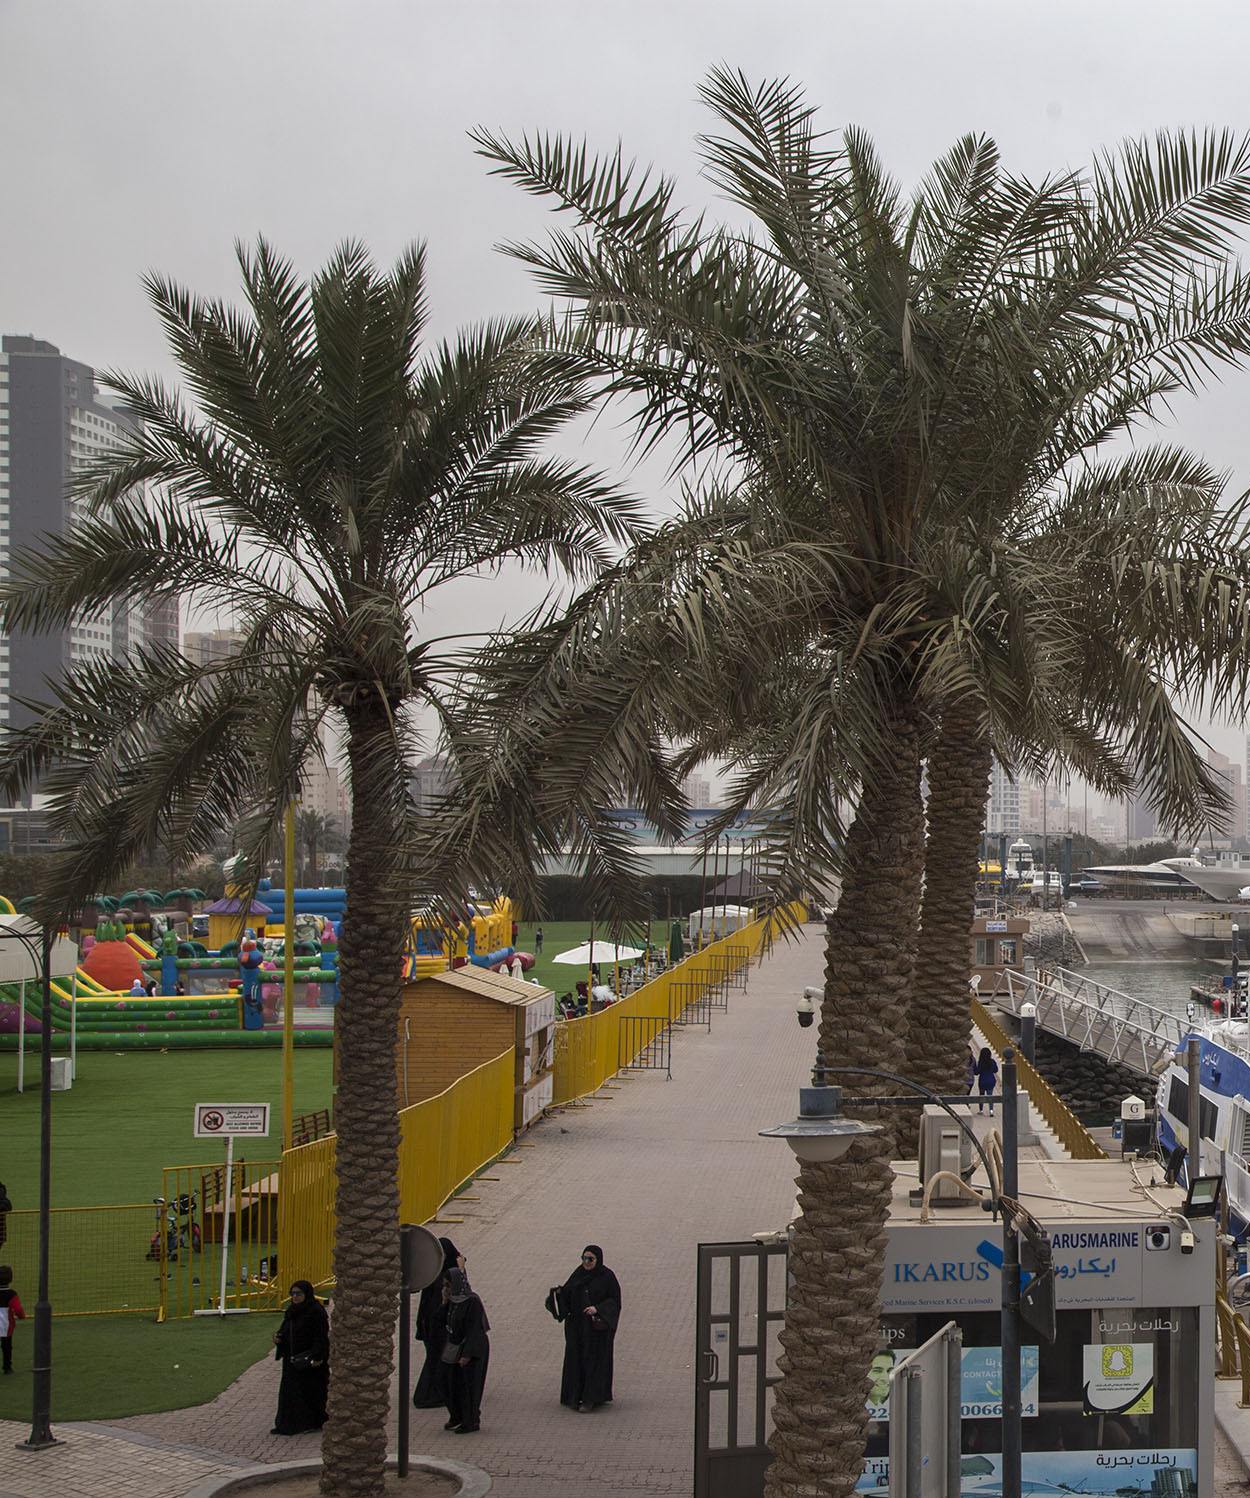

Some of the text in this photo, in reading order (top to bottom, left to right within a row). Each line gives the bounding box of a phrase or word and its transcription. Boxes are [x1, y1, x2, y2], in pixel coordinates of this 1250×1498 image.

[1130, 1103, 1139, 1114] G
[1052, 1232, 1139, 1249] ARUSMARINE
[894, 1261, 990, 1282] IKARUS
[878, 1325, 906, 1344] ips
[1099, 1318, 1179, 1335] رحلات بحرية
[1096, 1452, 1176, 1469] رحلات بحرية
